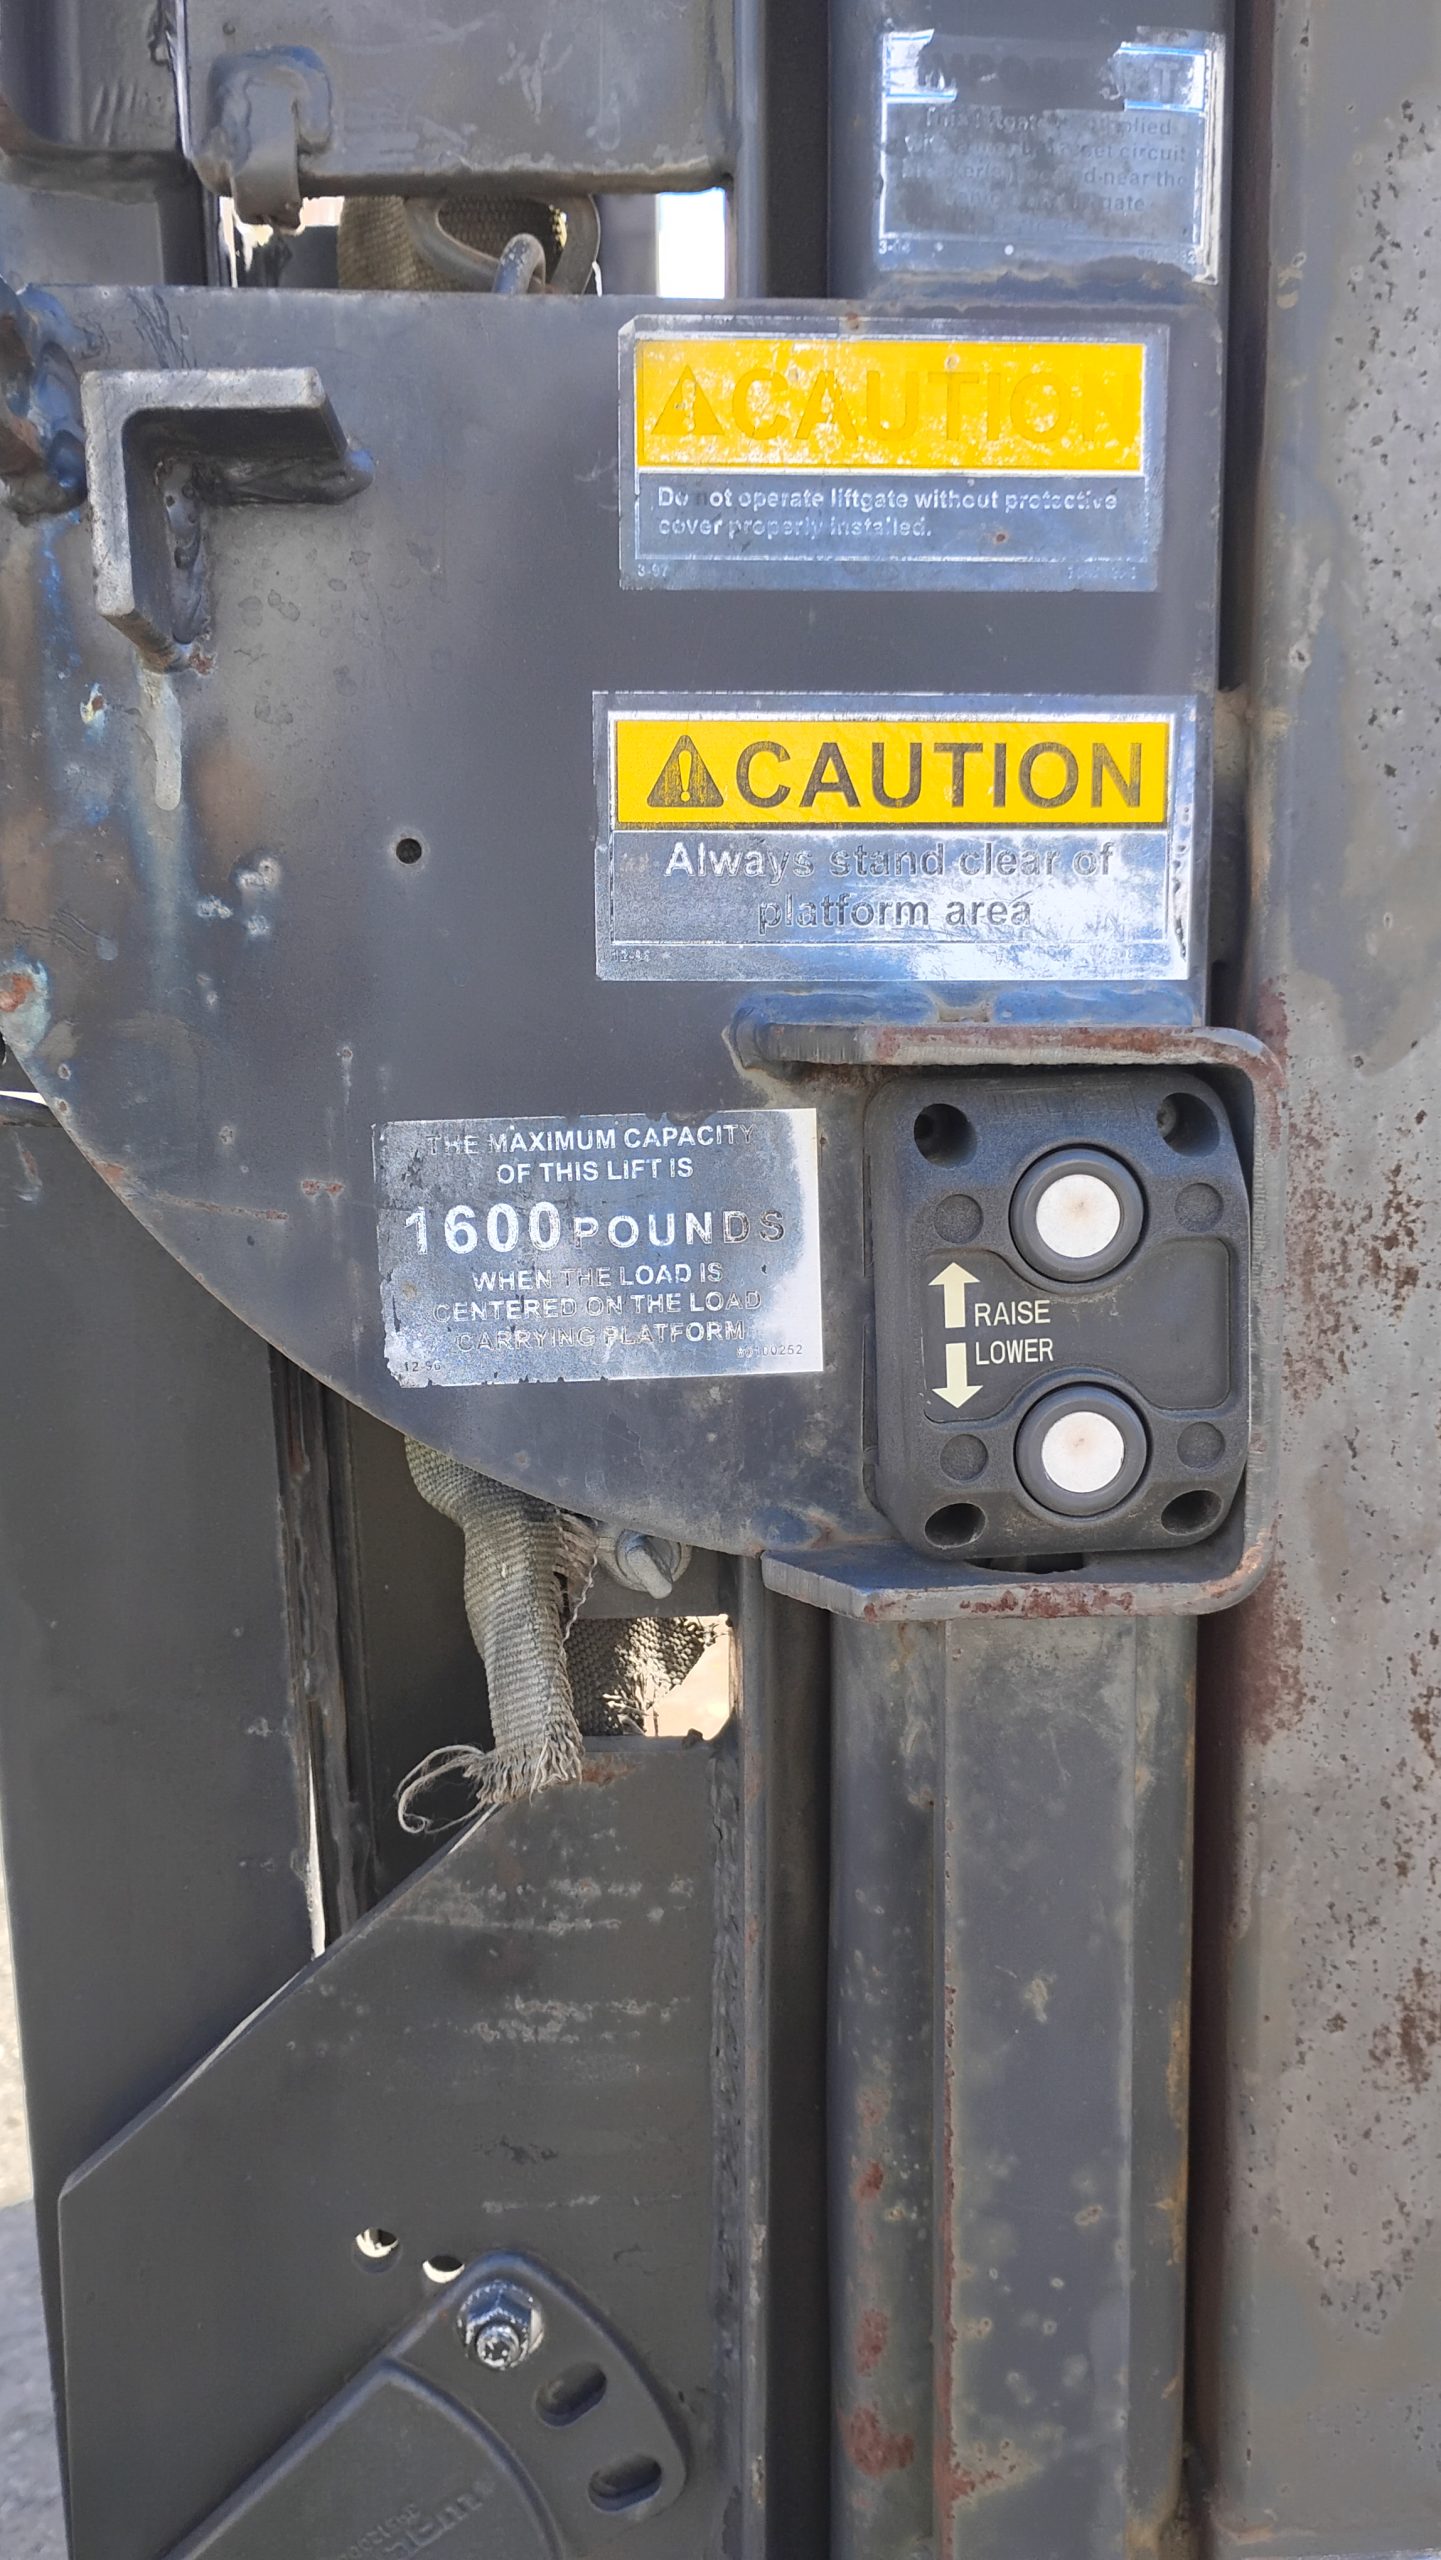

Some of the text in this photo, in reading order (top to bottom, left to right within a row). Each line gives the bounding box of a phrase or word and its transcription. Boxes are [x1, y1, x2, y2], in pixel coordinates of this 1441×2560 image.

[1104, 170, 1149, 186] near
[731, 367, 1136, 442] CAUTION
[658, 486, 689, 508] Do
[738, 488, 824, 512] operate
[831, 487, 909, 513] liftgate
[916, 488, 999, 510] without
[1005, 489, 1118, 514] protective
[658, 517, 722, 535] cover
[728, 518, 823, 541] properly
[735, 740, 1142, 810] CAUTION
[664, 841, 1117, 887] Always stand clear of
[757, 893, 1033, 935] platform area
[426, 1123, 756, 1157] THE MAXIMUM CAPACITY
[497, 1156, 694, 1185] OF THIS LIFT IS
[403, 1200, 786, 1256] 1600 POUNDS
[471, 1262, 723, 1293] WHEN THE LOAD IS
[432, 1290, 763, 1325] CENTERED ON THE LOAD
[974, 1300, 1051, 1327] RAISE
[457, 1320, 747, 1353] CARRYING PLATFORM
[975, 1338, 1055, 1366] LOWER
